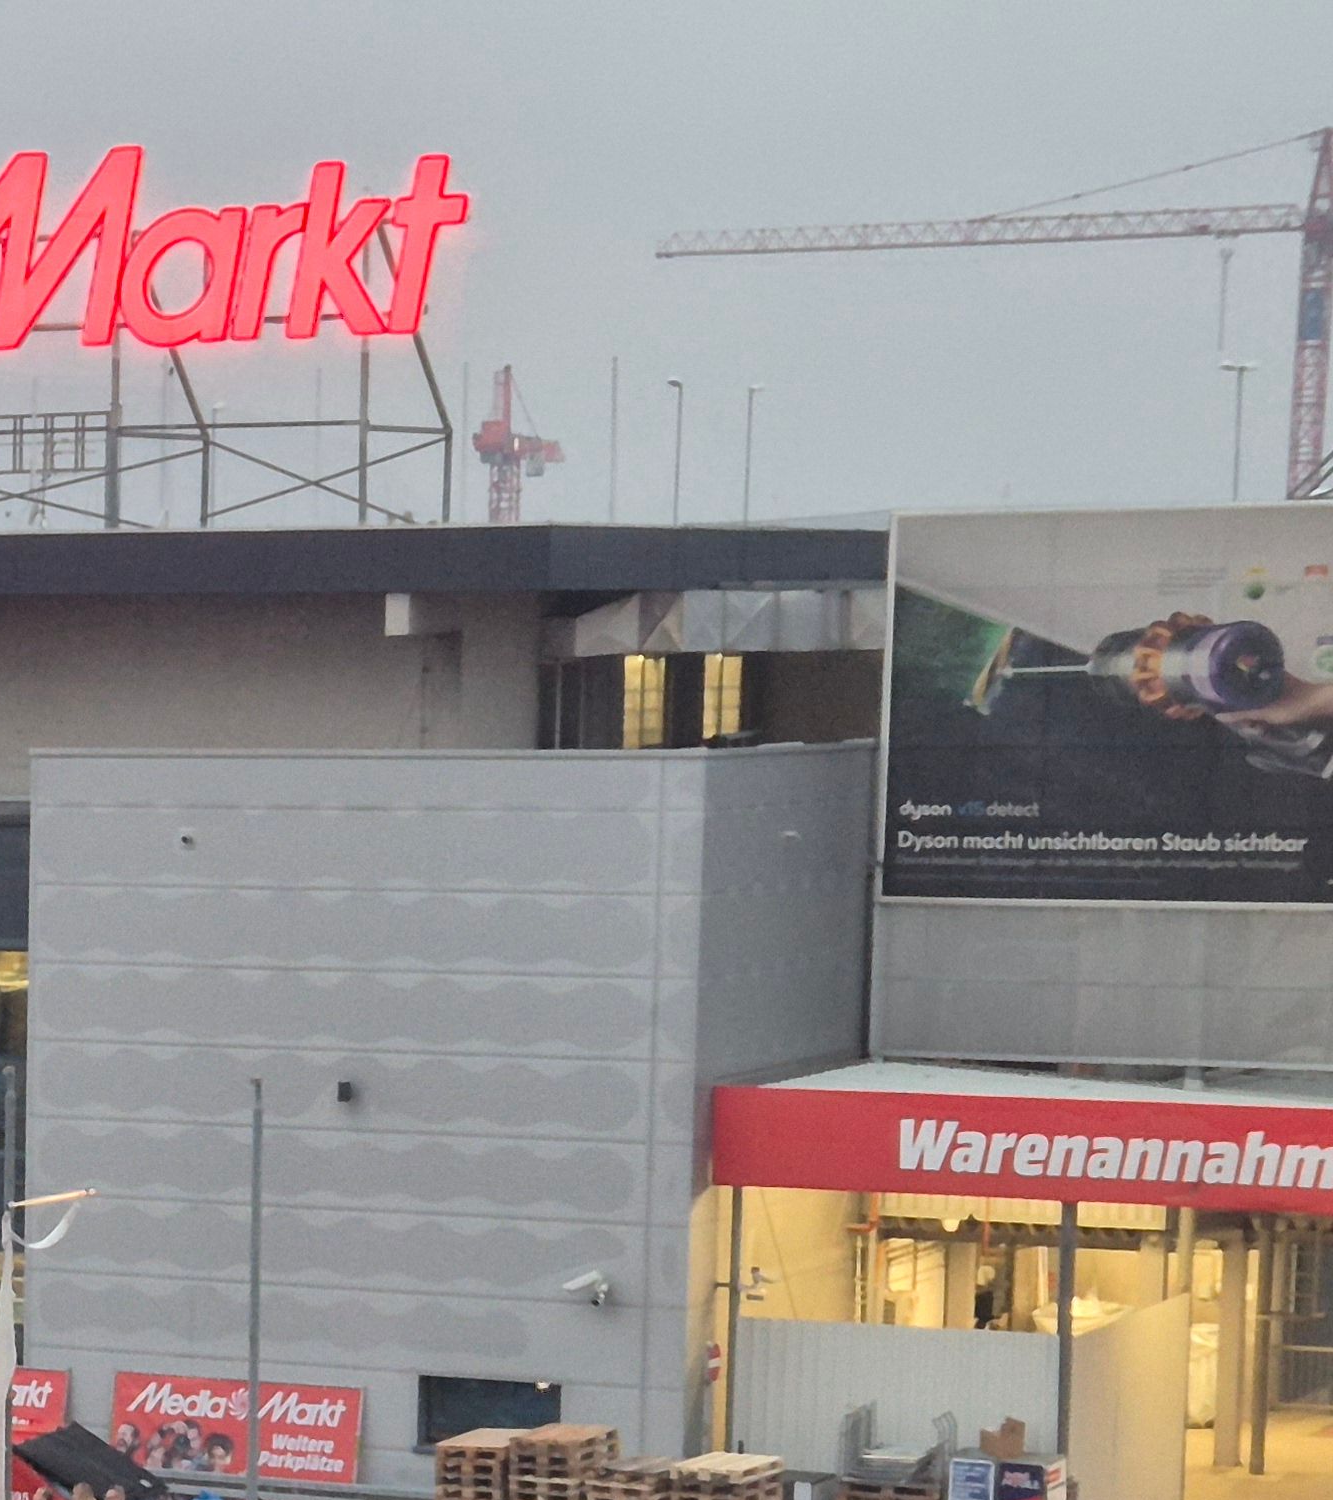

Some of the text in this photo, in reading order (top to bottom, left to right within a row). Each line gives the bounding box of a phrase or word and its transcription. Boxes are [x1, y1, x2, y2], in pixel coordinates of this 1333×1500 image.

[899, 800, 952, 822] dyson
[897, 829, 1309, 853] Dyson macht unsichtbaren Staub sichtbar
[899, 1117, 1333, 1190] Warenannahm
[126, 1381, 346, 1428] Media Markt
[272, 1433, 335, 1454] Weitere
[258, 1451, 345, 1473] Parkplätze
